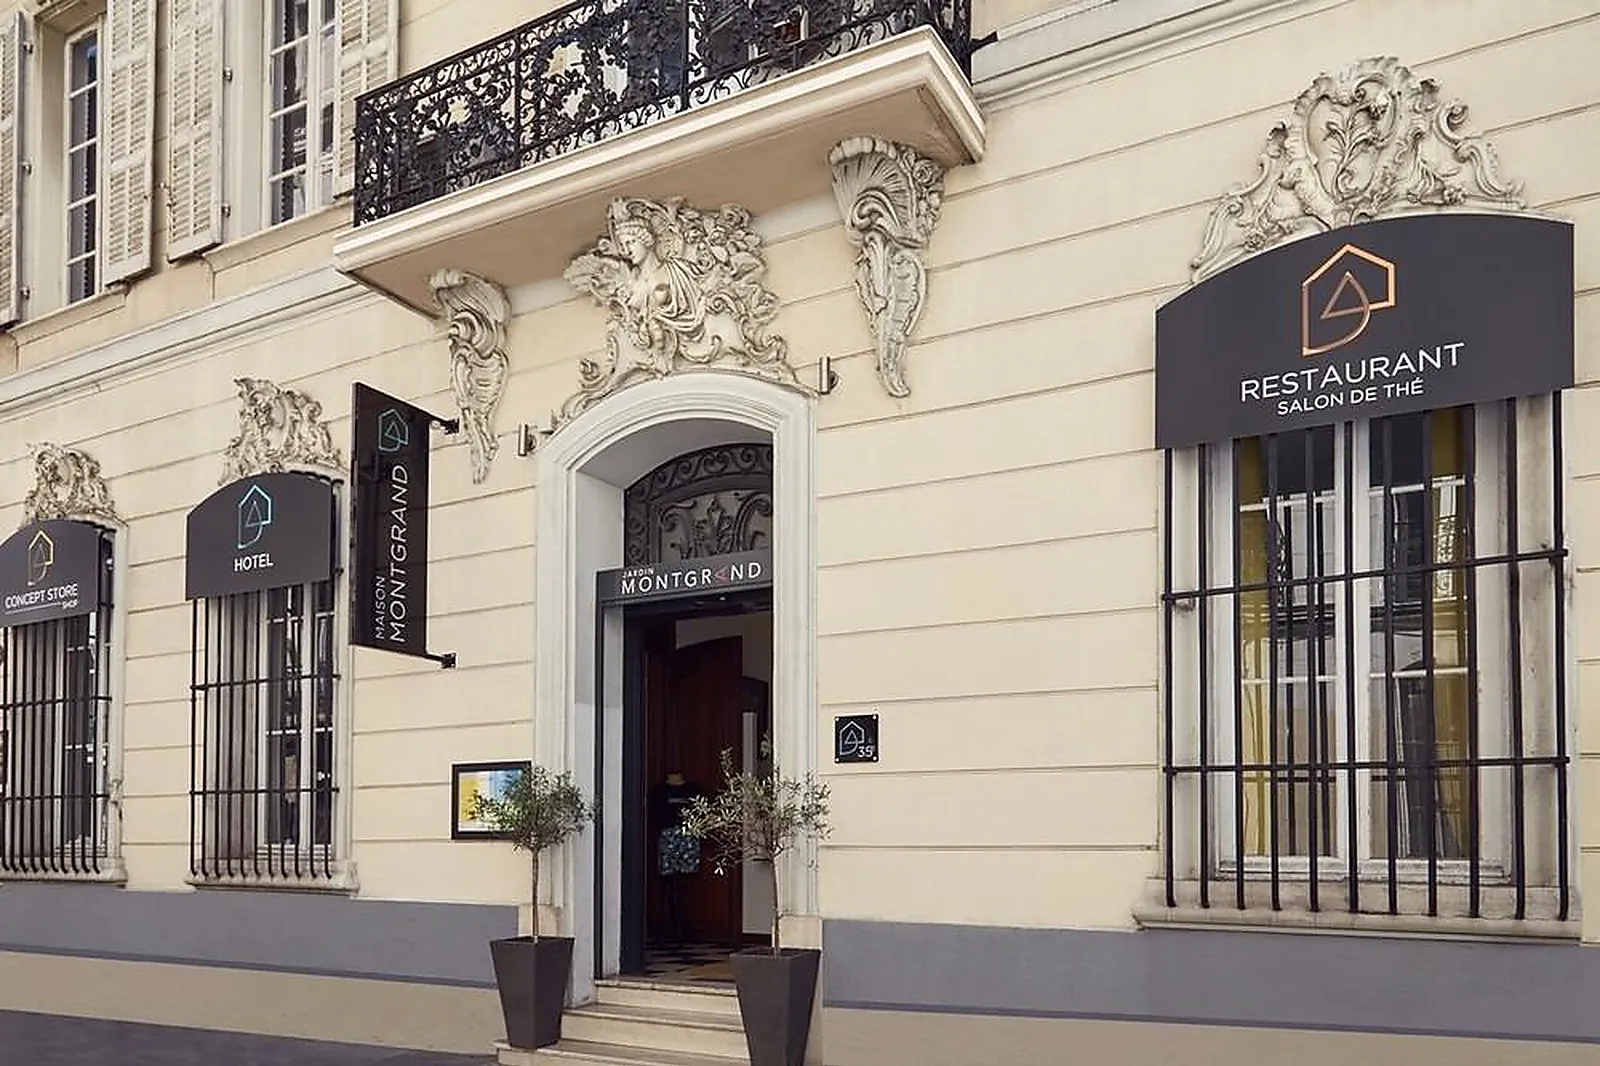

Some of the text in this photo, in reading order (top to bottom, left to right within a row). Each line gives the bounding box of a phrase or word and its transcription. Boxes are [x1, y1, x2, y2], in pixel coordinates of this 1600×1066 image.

[1240, 342, 1465, 402] RESTAURANT
[1277, 377, 1424, 416] SALON DE THÉ
[234, 554, 274, 572] HOTEL
[389, 465, 409, 642] MONTGRAND
[4, 583, 78, 609] CONCEPT STORE
[375, 575, 386, 640] MAISON
